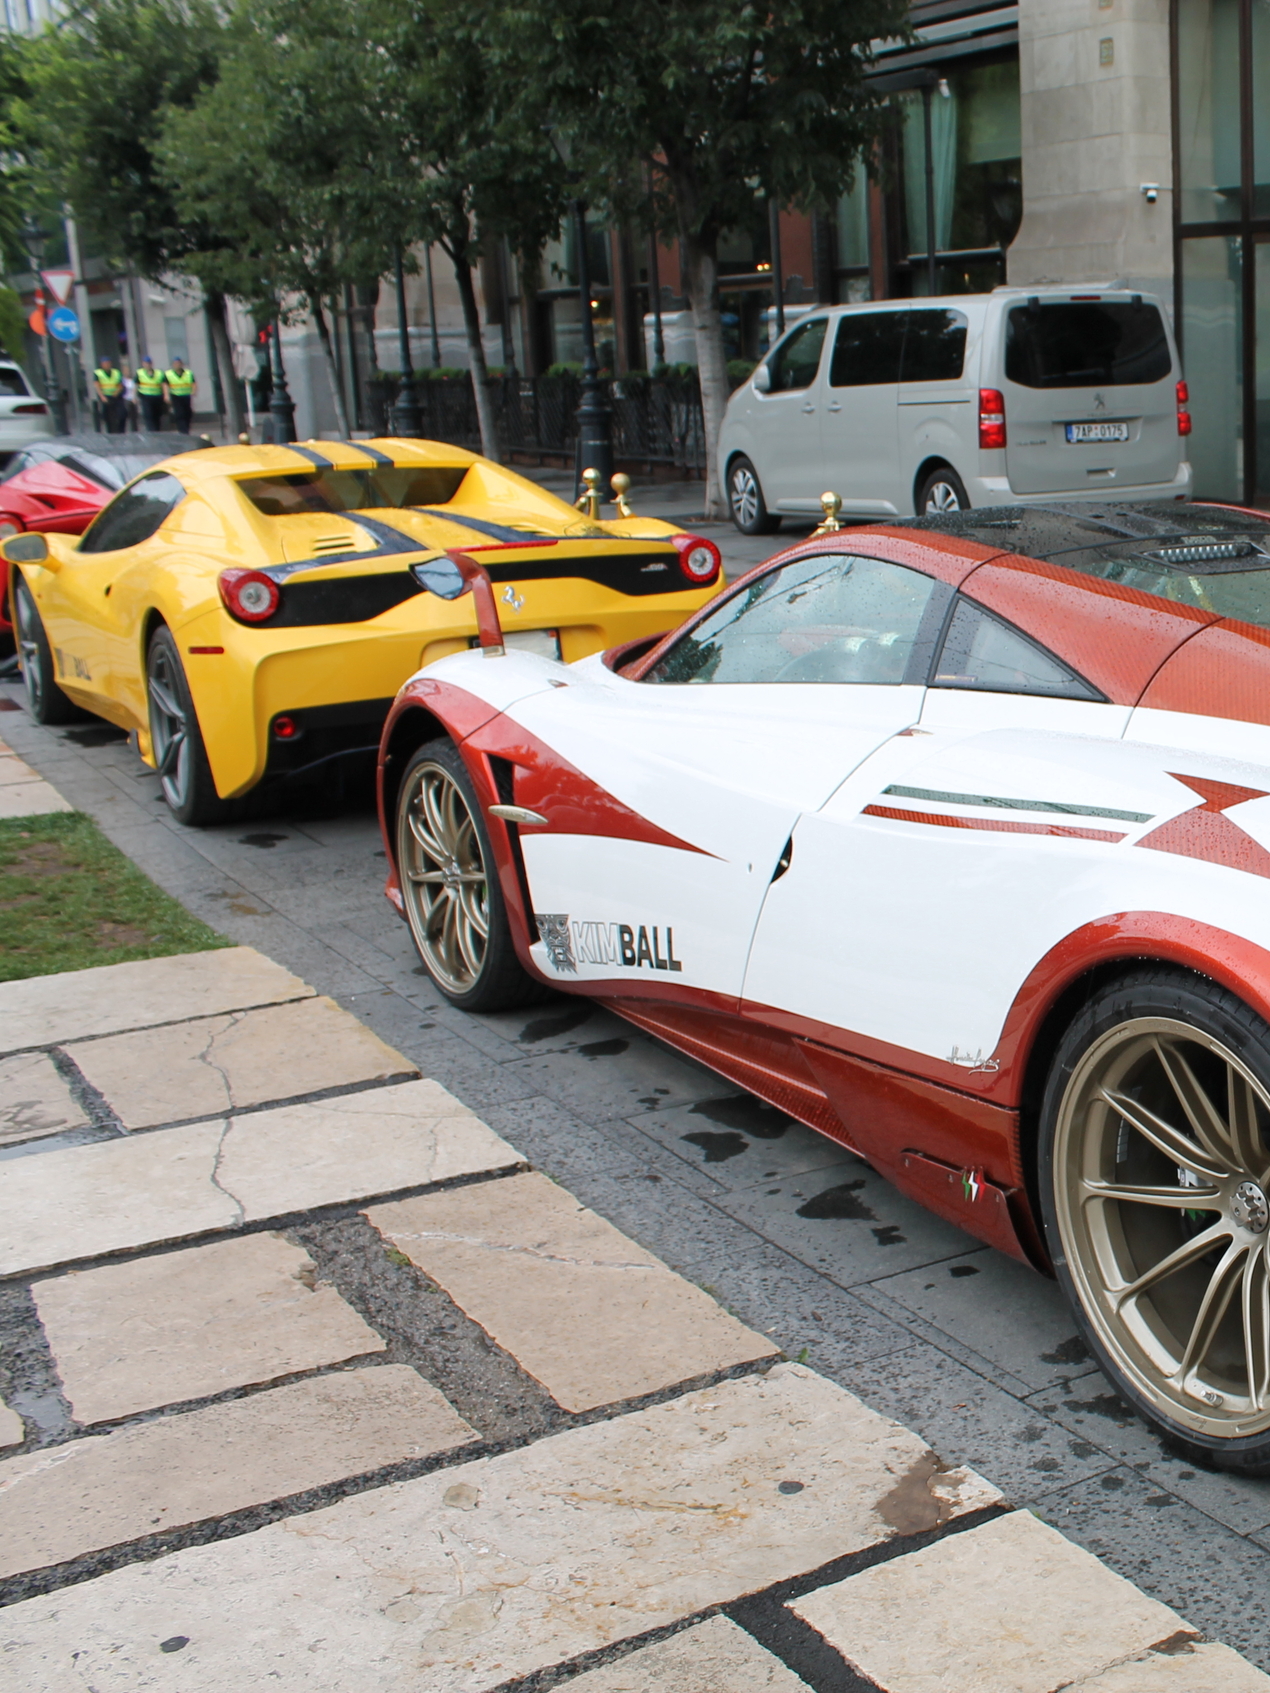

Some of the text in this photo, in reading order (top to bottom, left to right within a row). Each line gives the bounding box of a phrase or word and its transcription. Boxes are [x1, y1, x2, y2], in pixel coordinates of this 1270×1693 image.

[1075, 423, 1123, 438] 7AP 0175
[572, 921, 682, 972] KIMBALL
